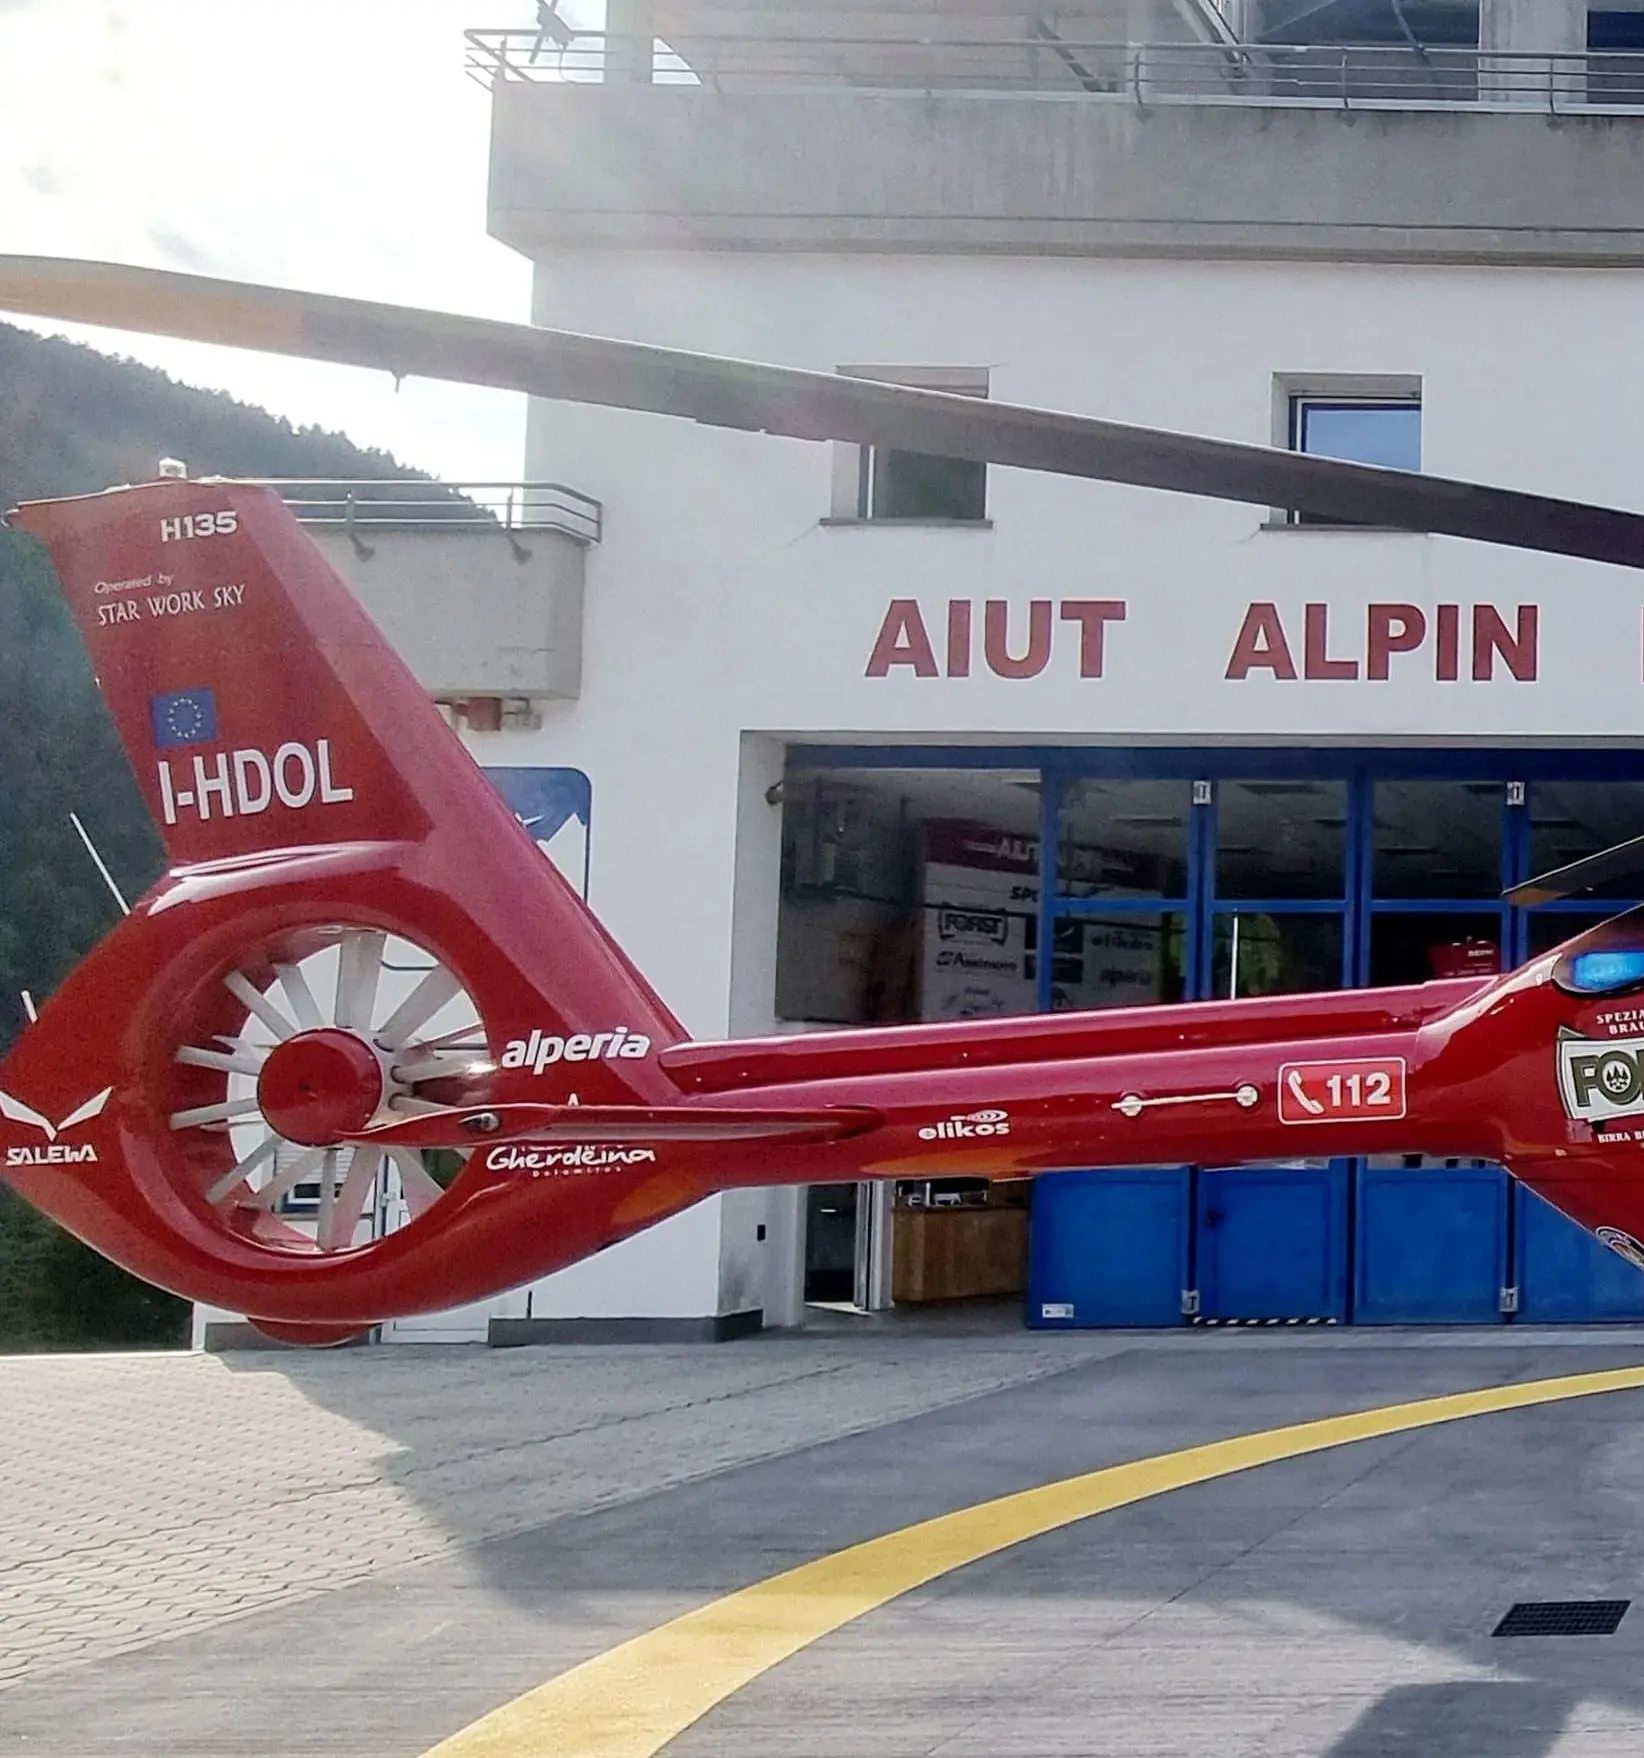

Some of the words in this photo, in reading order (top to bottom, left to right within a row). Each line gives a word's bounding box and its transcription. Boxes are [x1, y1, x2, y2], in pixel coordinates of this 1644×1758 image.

[160, 511, 238, 542] H135
[157, 572, 174, 586] by
[98, 600, 141, 626] STAR
[147, 590, 205, 617] WORK
[213, 583, 246, 608] SKY
[864, 599, 1127, 679] AIUT
[1224, 602, 1538, 681] ALPIN
[158, 739, 354, 824] I-HDOL
[501, 1026, 651, 1075] alperia
[1326, 1071, 1392, 1107] 112
[5, 1144, 98, 1166] SALEWA
[1597, 1131, 1631, 1144] BIRRA
